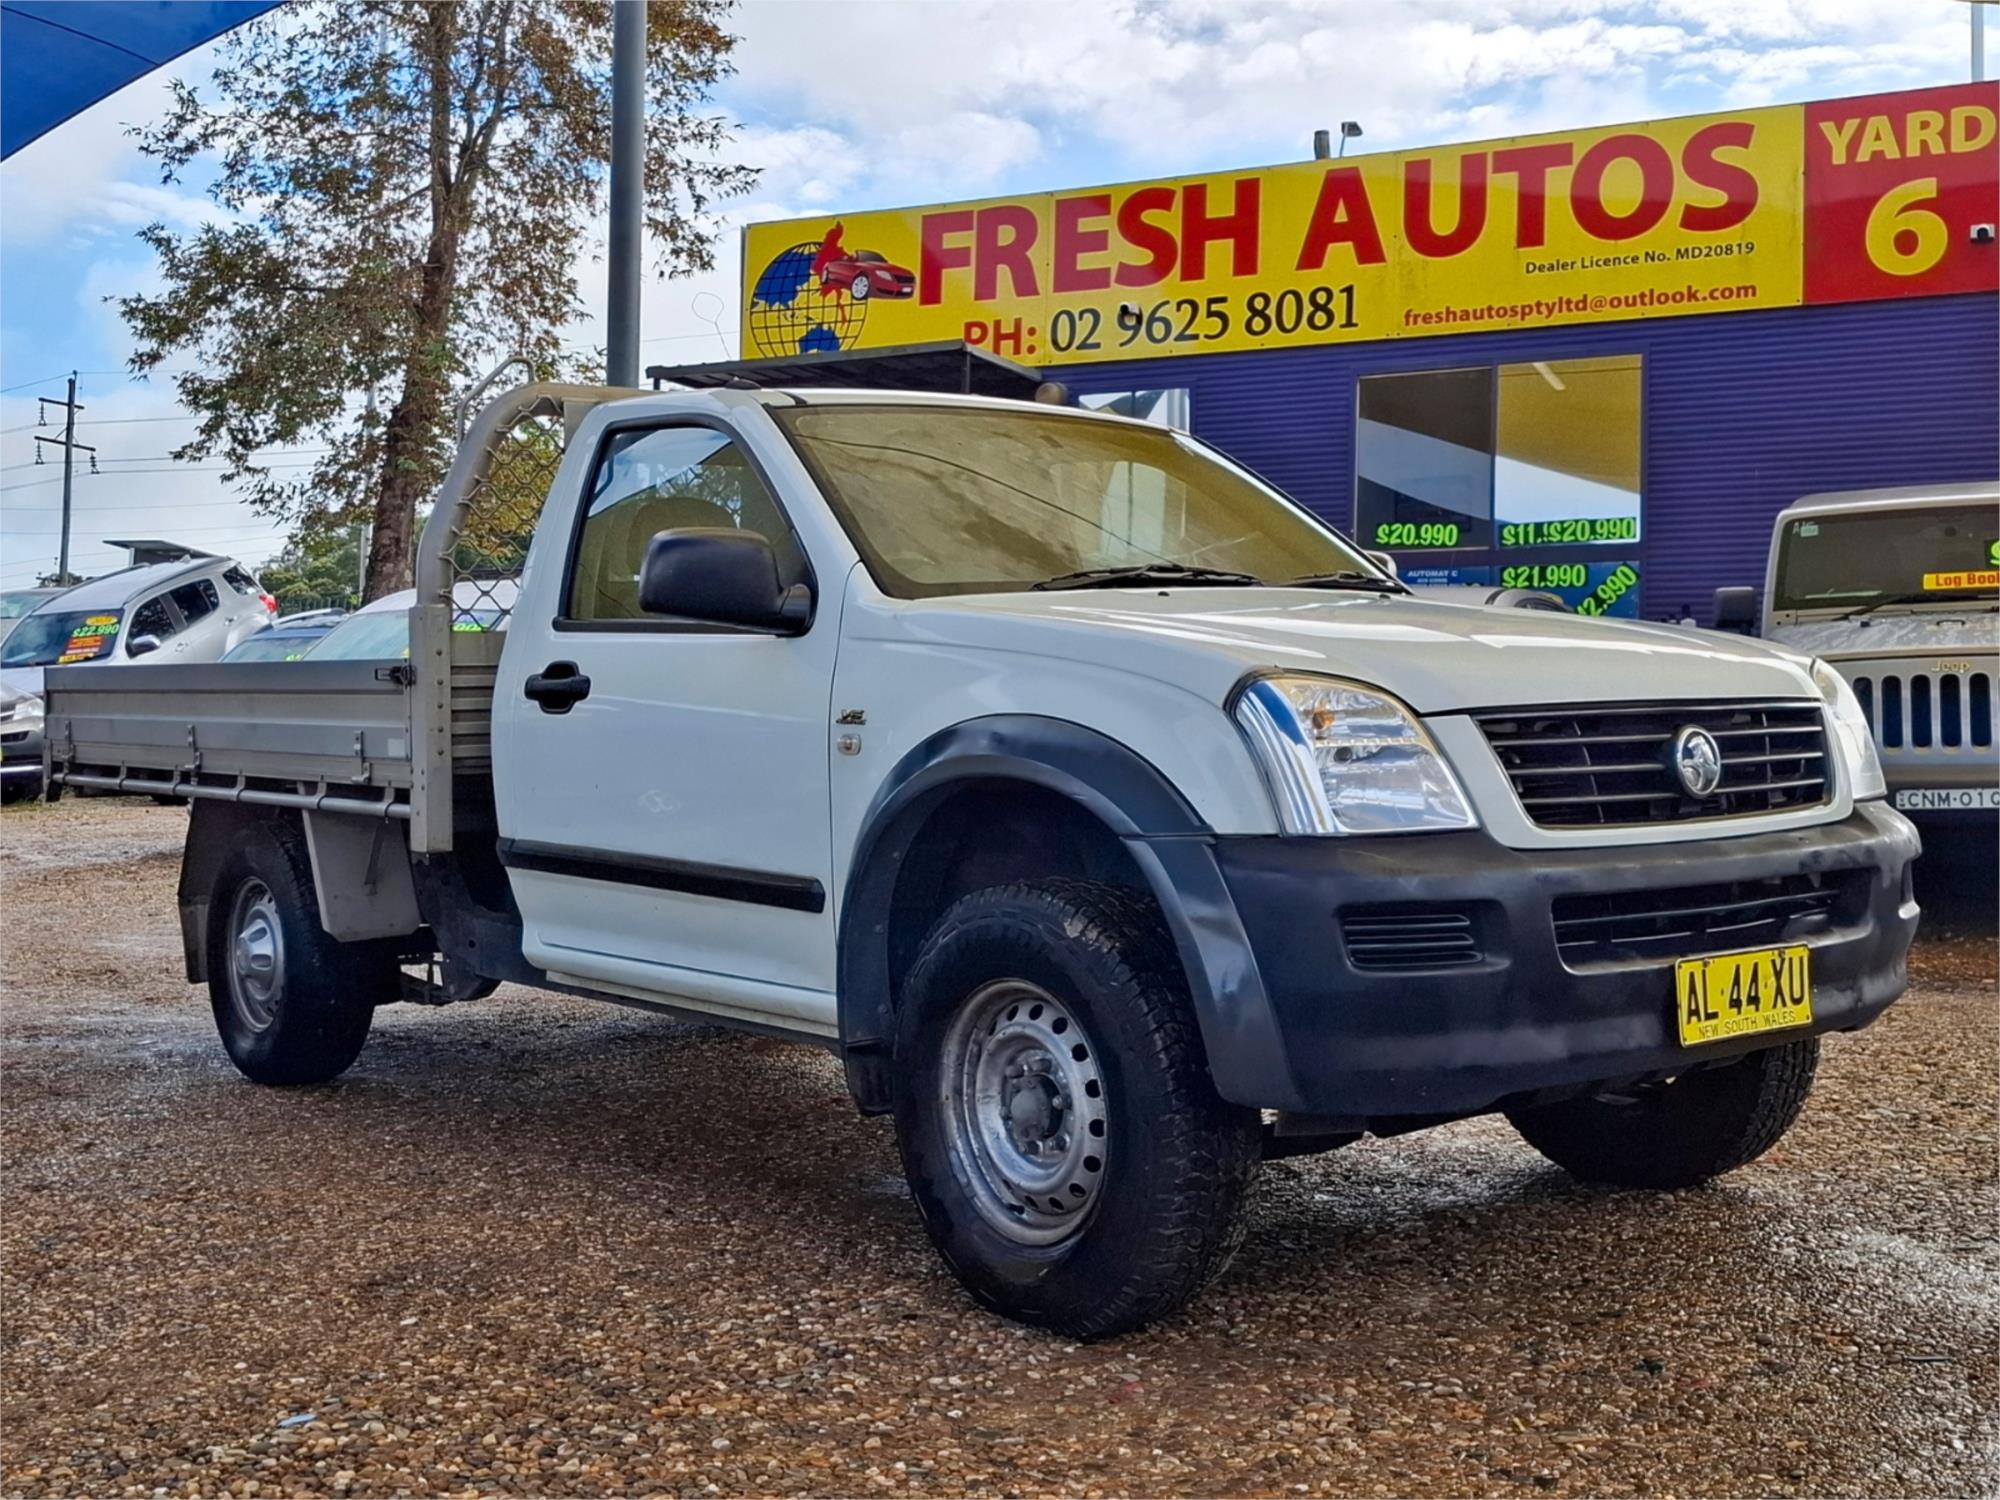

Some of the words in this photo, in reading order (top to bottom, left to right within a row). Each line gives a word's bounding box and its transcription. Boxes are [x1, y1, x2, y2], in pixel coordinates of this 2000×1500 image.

[1818, 105, 1997, 165] YARD
[918, 177, 1261, 306] FRESH
[1296, 121, 1759, 271] AUTOS
[1864, 177, 1949, 276] 6
[1525, 259, 1577, 274] Dealer
[1580, 254, 1640, 269] Licence
[1644, 250, 1671, 264] No.
[1675, 241, 1755, 261] MD20819
[963, 317, 1037, 356] PH:
[1050, 308, 1101, 352] 02
[1117, 296, 1230, 347] 9625
[1244, 284, 1359, 336] 8081
[1403, 284, 1758, 327] freshautosptyltd@outlook.com
[1375, 523, 1459, 546] $20.990
[1502, 564, 1587, 588] $21.990
[1935, 574, 1962, 588] Log
[1698, 1023, 1719, 1039] NEW
[1725, 1016, 1758, 1035] SOUTH
[1763, 1010, 1797, 1026] WALES
